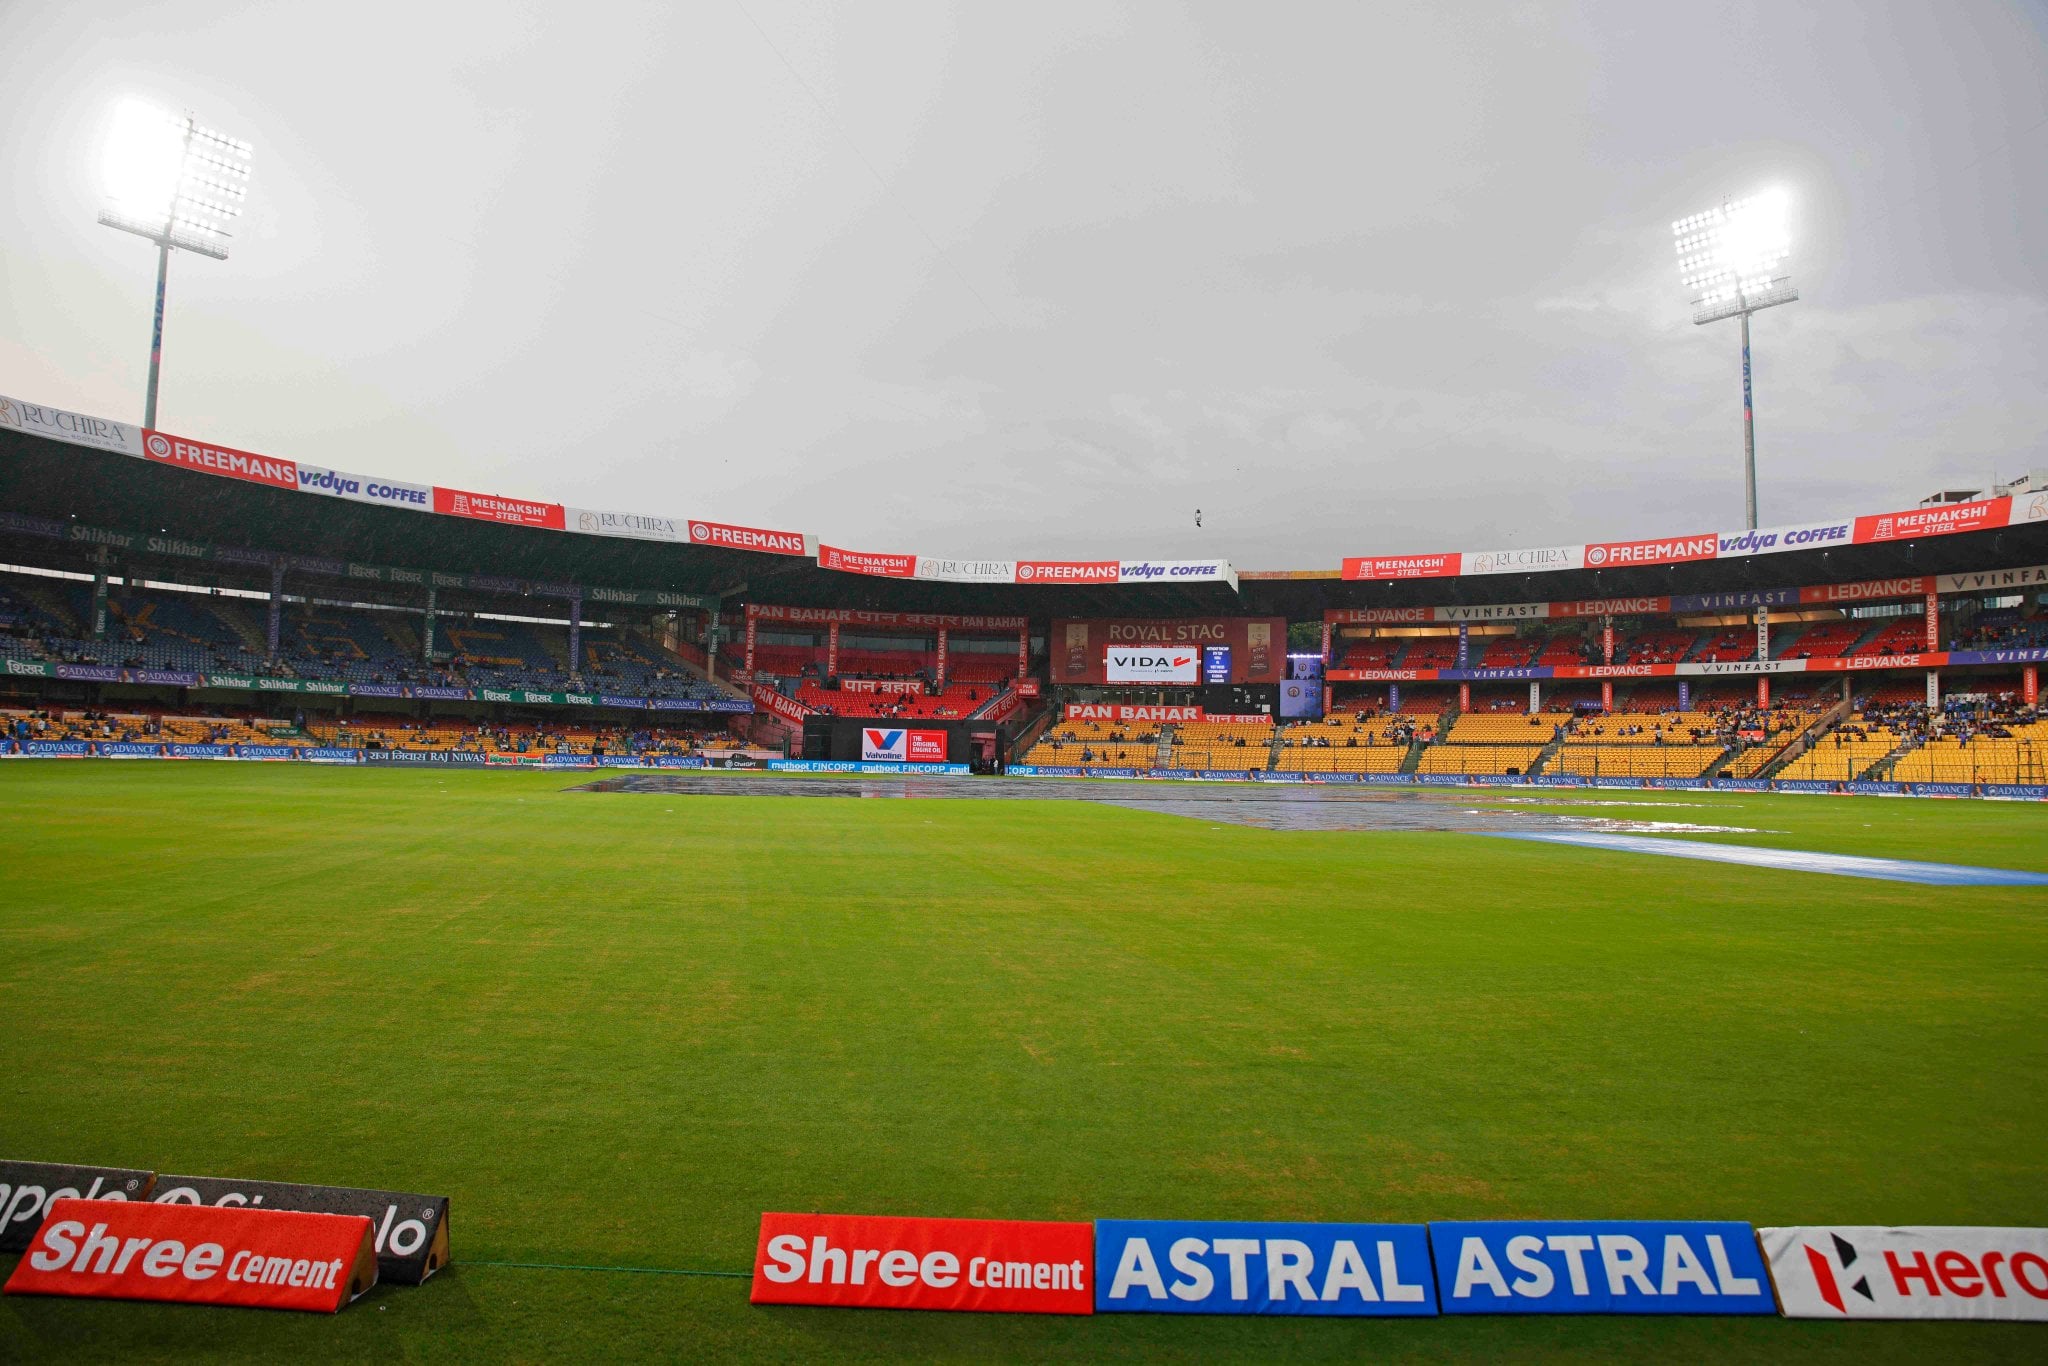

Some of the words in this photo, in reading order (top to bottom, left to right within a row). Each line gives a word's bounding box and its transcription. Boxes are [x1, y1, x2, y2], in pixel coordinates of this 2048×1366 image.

[21, 401, 125, 441] RUCHIRA
[173, 442, 296, 483] FREEMANS
[298, 470, 360, 495] vidya
[366, 483, 427, 505] COFFEE
[471, 497, 547, 517] MEENAKSHI
[495, 511, 524, 522] STEEL
[601, 513, 675, 533] RUCHIRA
[1897, 505, 1987, 527] MEENAKSHI
[1923, 522, 1956, 534] STEEL
[70, 525, 133, 548] Shikhar
[147, 538, 207, 556] Shikhar
[712, 527, 802, 551] FREEMANS
[1719, 531, 1778, 553] vidya
[1784, 525, 1849, 545] COFFEE
[1609, 538, 1715, 562] FREEMANS
[843, 554, 908, 568] MEENAKSHI
[1376, 558, 1444, 570] MEENAKSHI
[1496, 549, 1568, 566] RUCHIRA
[863, 565, 887, 574] STEEL
[942, 561, 1009, 575] RUCHIRA
[1036, 566, 1117, 578] FREEMANS
[1121, 563, 1165, 579] vidya
[1170, 565, 1217, 576] COFFEE
[1396, 568, 1422, 577] STEEL
[1828, 578, 1923, 600] LEDVANCE
[591, 588, 639, 603] Shikhar
[656, 592, 704, 607] Shikhar
[1702, 592, 1787, 607] VINFAST
[750, 605, 784, 618] PAN
[789, 607, 851, 621] BAHAR
[1462, 605, 1538, 618] VINFAST
[1576, 599, 1659, 615] LEDVANCE
[857, 611, 900, 623] पान
[906, 614, 960, 626] बहार
[962, 616, 984, 627] PAN
[987, 616, 1025, 628] BAHAR
[1350, 609, 1425, 622] LEDVANCE
[1927, 594, 1936, 645] LEDVANCE
[747, 619, 756, 650] BAHAR
[1109, 624, 1172, 641] ROYAL
[1176, 623, 1225, 640] STAG
[938, 630, 946, 660] BAHAR
[1322, 623, 1330, 657] LEDVANCE
[6, 659, 47, 675] शिखर
[746, 652, 754, 670] PAN
[1114, 657, 1169, 667] VIDA
[1716, 663, 1782, 672] VINFAST
[1847, 655, 1920, 668] LEDVANCE
[69, 667, 117, 678] ADVANCE
[148, 672, 194, 682] ADVANCE
[937, 663, 945, 679] PAN
[1359, 670, 1417, 680] LEDVANCE
[1473, 669, 1532, 678] VINFAST
[1589, 665, 1652, 676] LEDVANCE
[211, 676, 251, 688] Shikhar
[259, 680, 298, 690] Shikhar
[306, 682, 343, 693] Shikhar
[358, 685, 398, 694] ADVANCE
[844, 680, 876, 693] पान
[882, 681, 921, 694] बहार
[425, 688, 463, 697] ADVANCE
[483, 689, 511, 702] शिखर
[525, 691, 552, 703] शिखर
[566, 693, 593, 705] शिखर
[754, 686, 775, 706] PAN
[610, 698, 643, 706] ADVANCE
[663, 700, 697, 709] ADVANCE
[718, 702, 750, 710] ADVANCE
[1069, 705, 1113, 718] PAN
[1120, 706, 1197, 720] BAHAR
[1206, 714, 1231, 723] पान
[1236, 714, 1268, 723] बहार
[37, 743, 84, 753] ADVANCE
[112, 745, 155, 754] ADVANCE
[182, 746, 224, 755] ADVANCE
[250, 748, 289, 757] ADVANCE
[315, 750, 353, 758] ADVANCE
[369, 751, 389, 760] राज
[392, 749, 426, 761] निवास
[865, 751, 902, 759] Valvoline
[430, 752, 449, 762] RAJ
[452, 753, 485, 763] NIWAS
[553, 755, 588, 763] ADVANCE
[771, 762, 810, 770] muthoot
[812, 762, 855, 772] FINCORP
[862, 764, 899, 772] muthoot
[903, 764, 945, 773] FINCORP
[1789, 782, 1830, 790] ADVANCE
[1856, 783, 1899, 792] ADVANCE
[1925, 785, 1969, 794] ADVANCE
[1998, 787, 2044, 796] ADVANCE
[30, 1220, 224, 1280] Shree
[226, 1250, 342, 1290] Cement
[763, 1233, 960, 1289] Shree
[968, 1256, 1084, 1291] Cement
[1108, 1237, 1425, 1302] ASTRAL
[1453, 1234, 1761, 1299] ASTRAL
[1883, 1250, 2048, 1300] Hero
